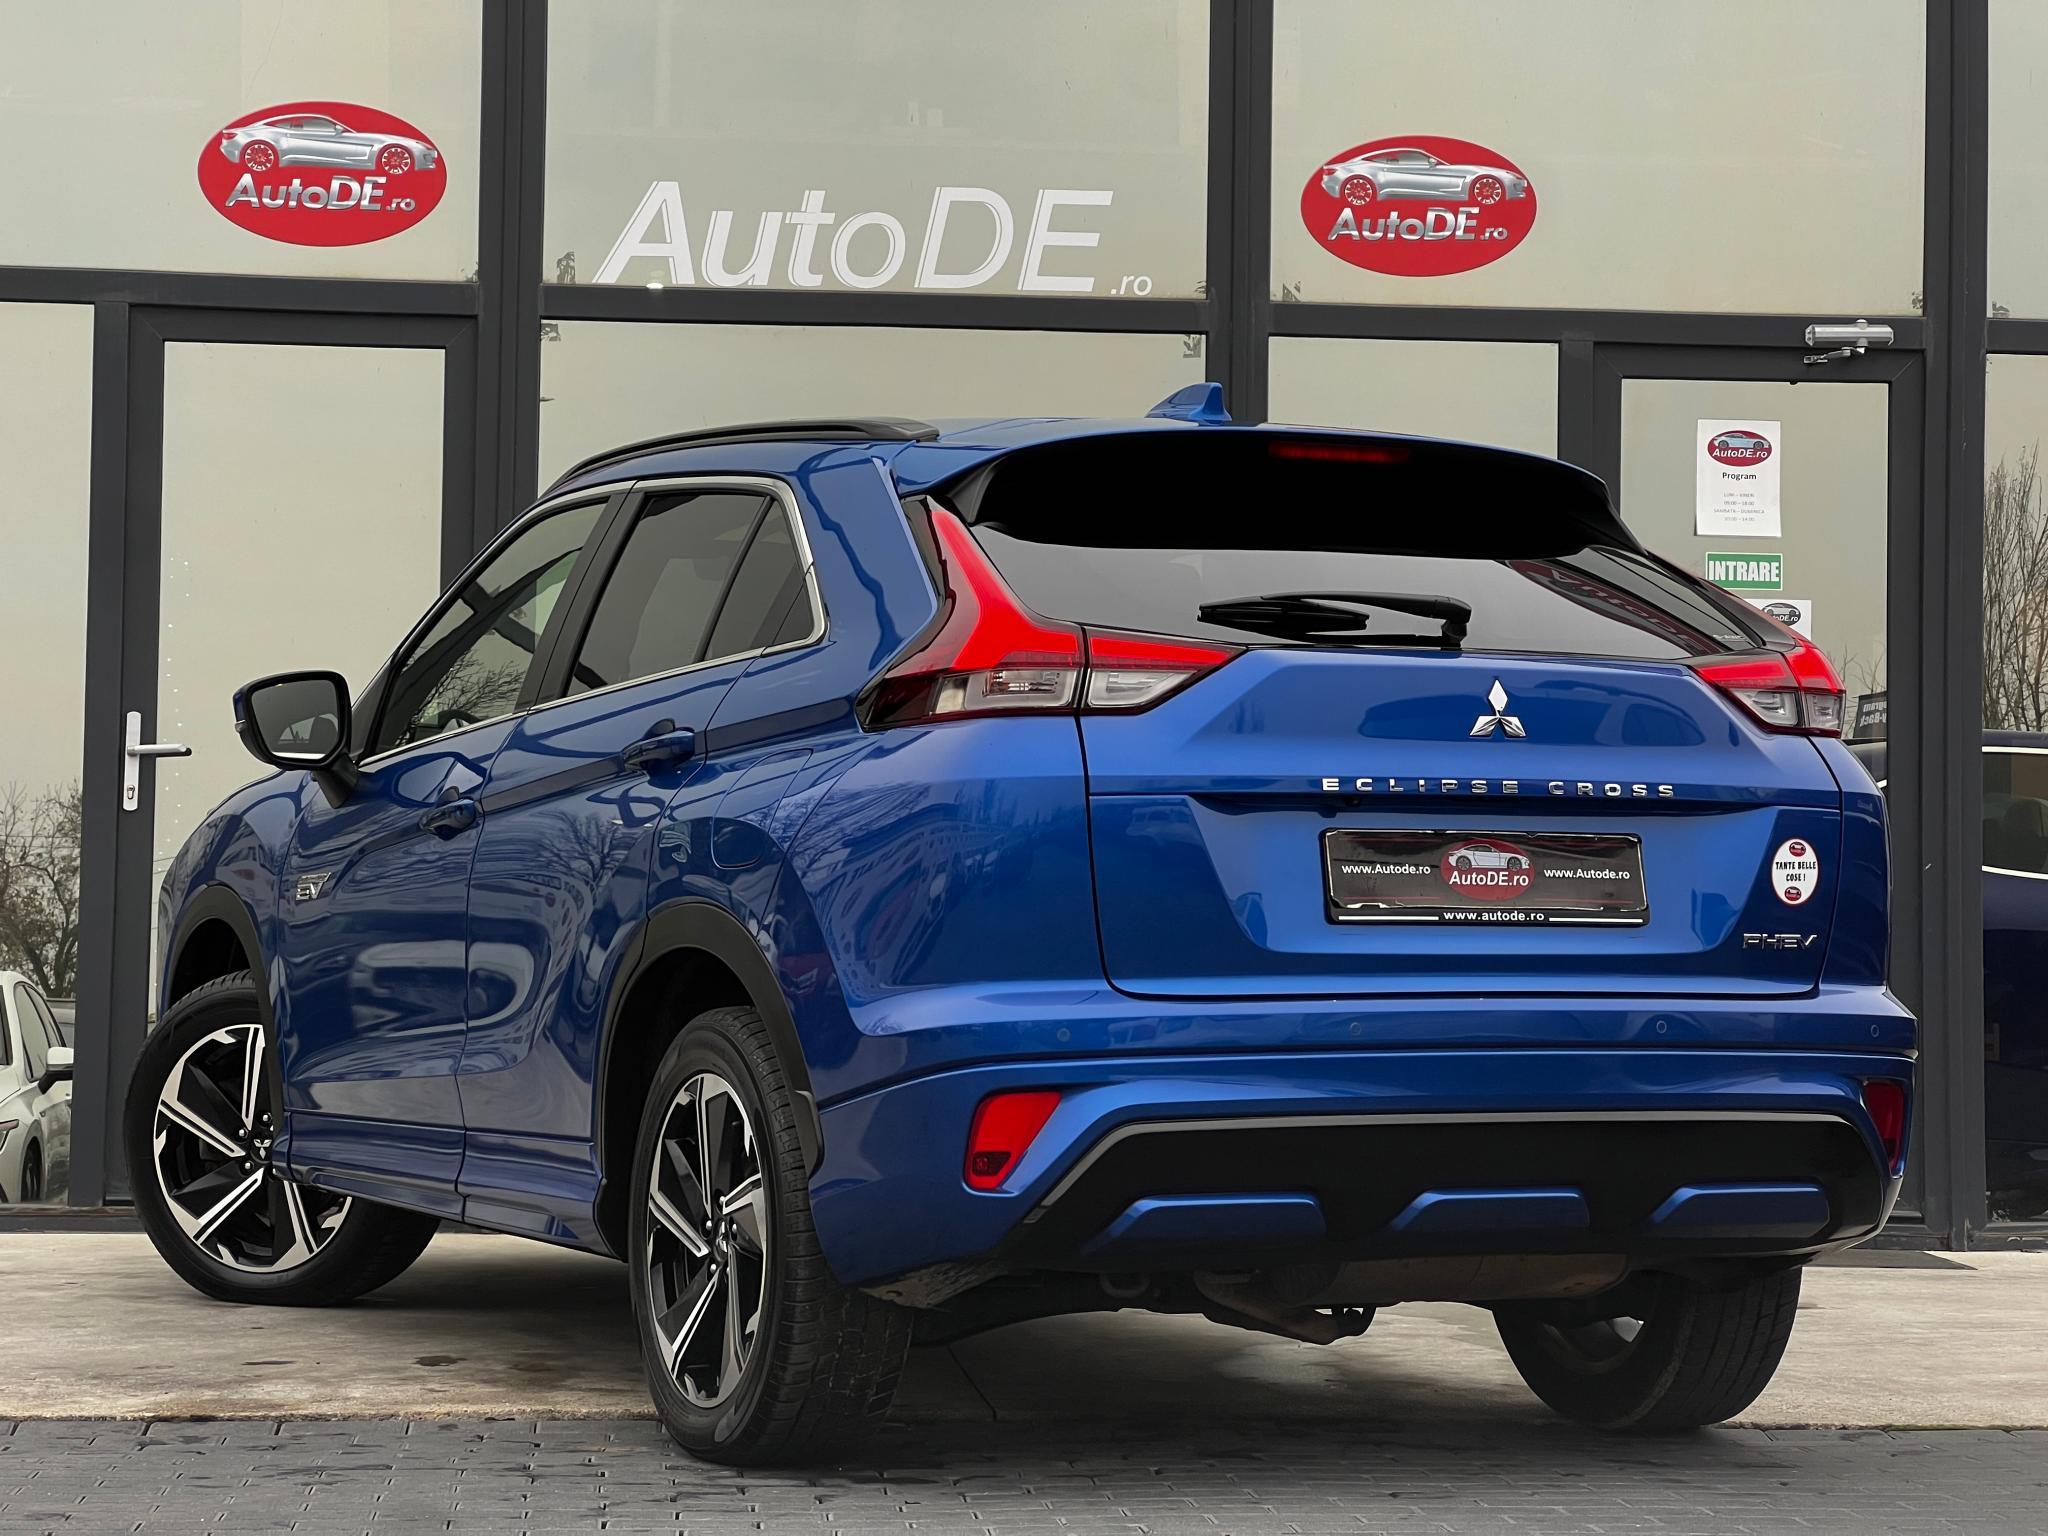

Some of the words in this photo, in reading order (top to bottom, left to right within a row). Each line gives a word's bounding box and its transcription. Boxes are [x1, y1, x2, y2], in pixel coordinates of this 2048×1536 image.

[1711, 448, 1769, 459] AutoDE.ro
[1722, 472, 1757, 481] Program
[1708, 560, 1780, 582] INTRARE
[1321, 777, 1519, 795] ECLIPSE
[1548, 780, 1675, 798] CROSS
[1775, 861, 1796, 870] TANTE
[1797, 861, 1817, 870] BELLE
[1341, 863, 1431, 876] www.Autode.ro
[1448, 870, 1529, 887] AutoDE.ro
[1543, 867, 1631, 880] www.Autode.ro
[1785, 873, 1802, 882] COSE
[1443, 910, 1545, 922] www.autode.ro
[1742, 933, 1818, 950] PHEV
